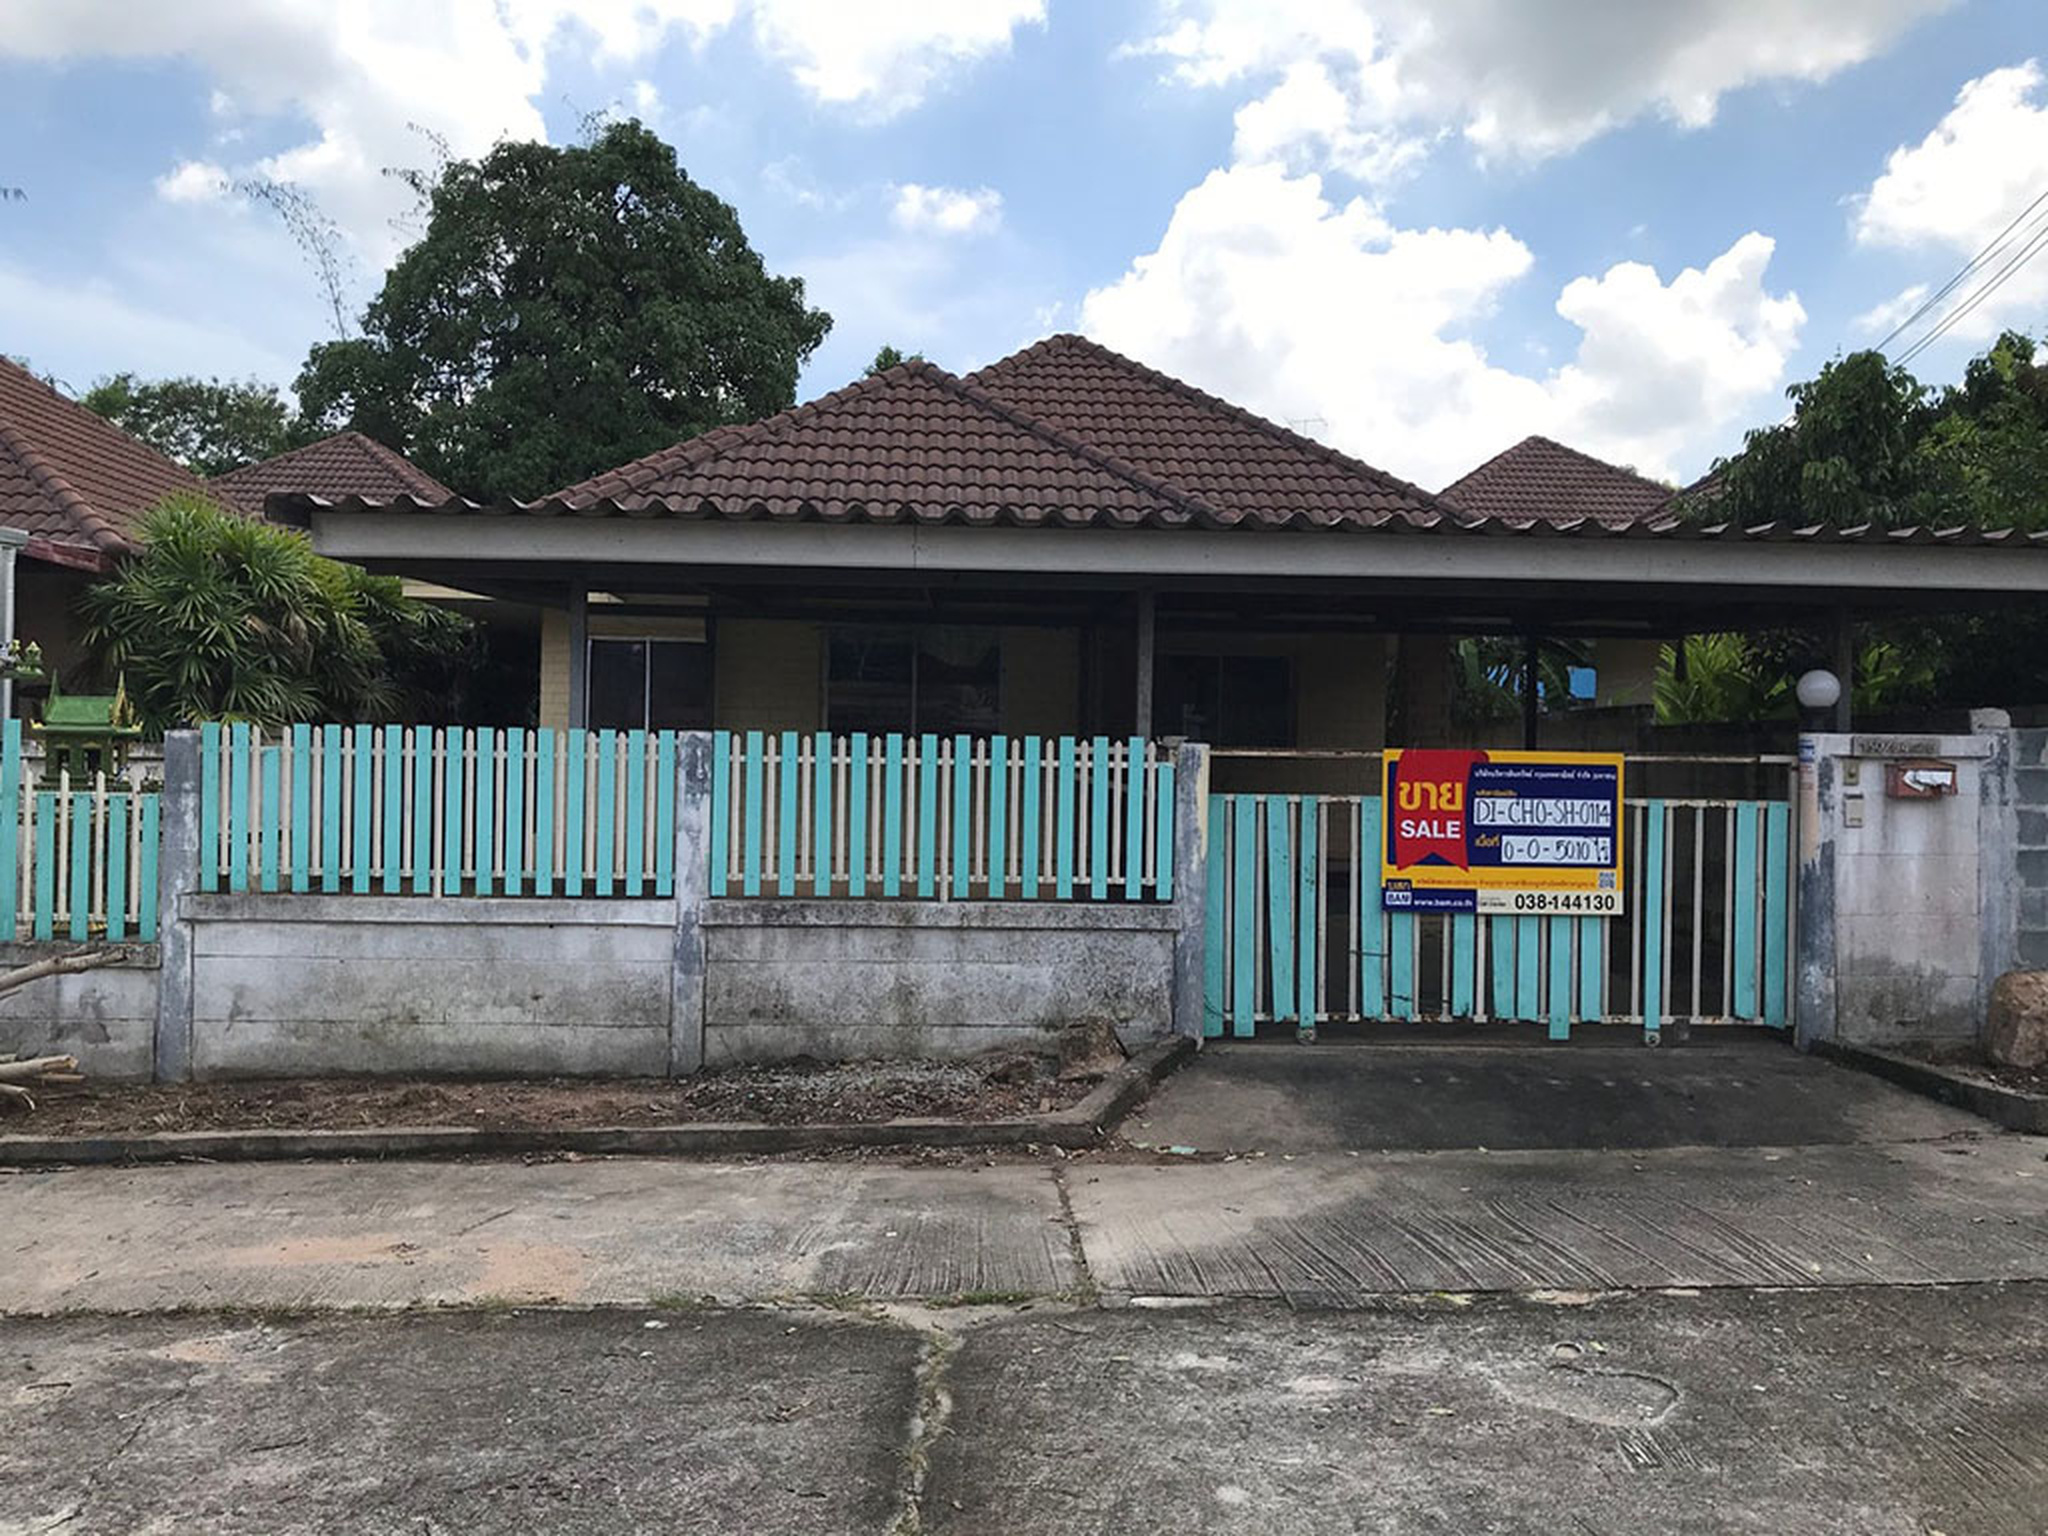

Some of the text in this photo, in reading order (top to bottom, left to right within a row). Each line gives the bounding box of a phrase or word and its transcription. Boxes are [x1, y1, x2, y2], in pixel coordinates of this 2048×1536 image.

[1399, 781, 1463, 811] ขาย
[1401, 819, 1461, 839] SALE
[1515, 894, 1615, 911] 038-144130
